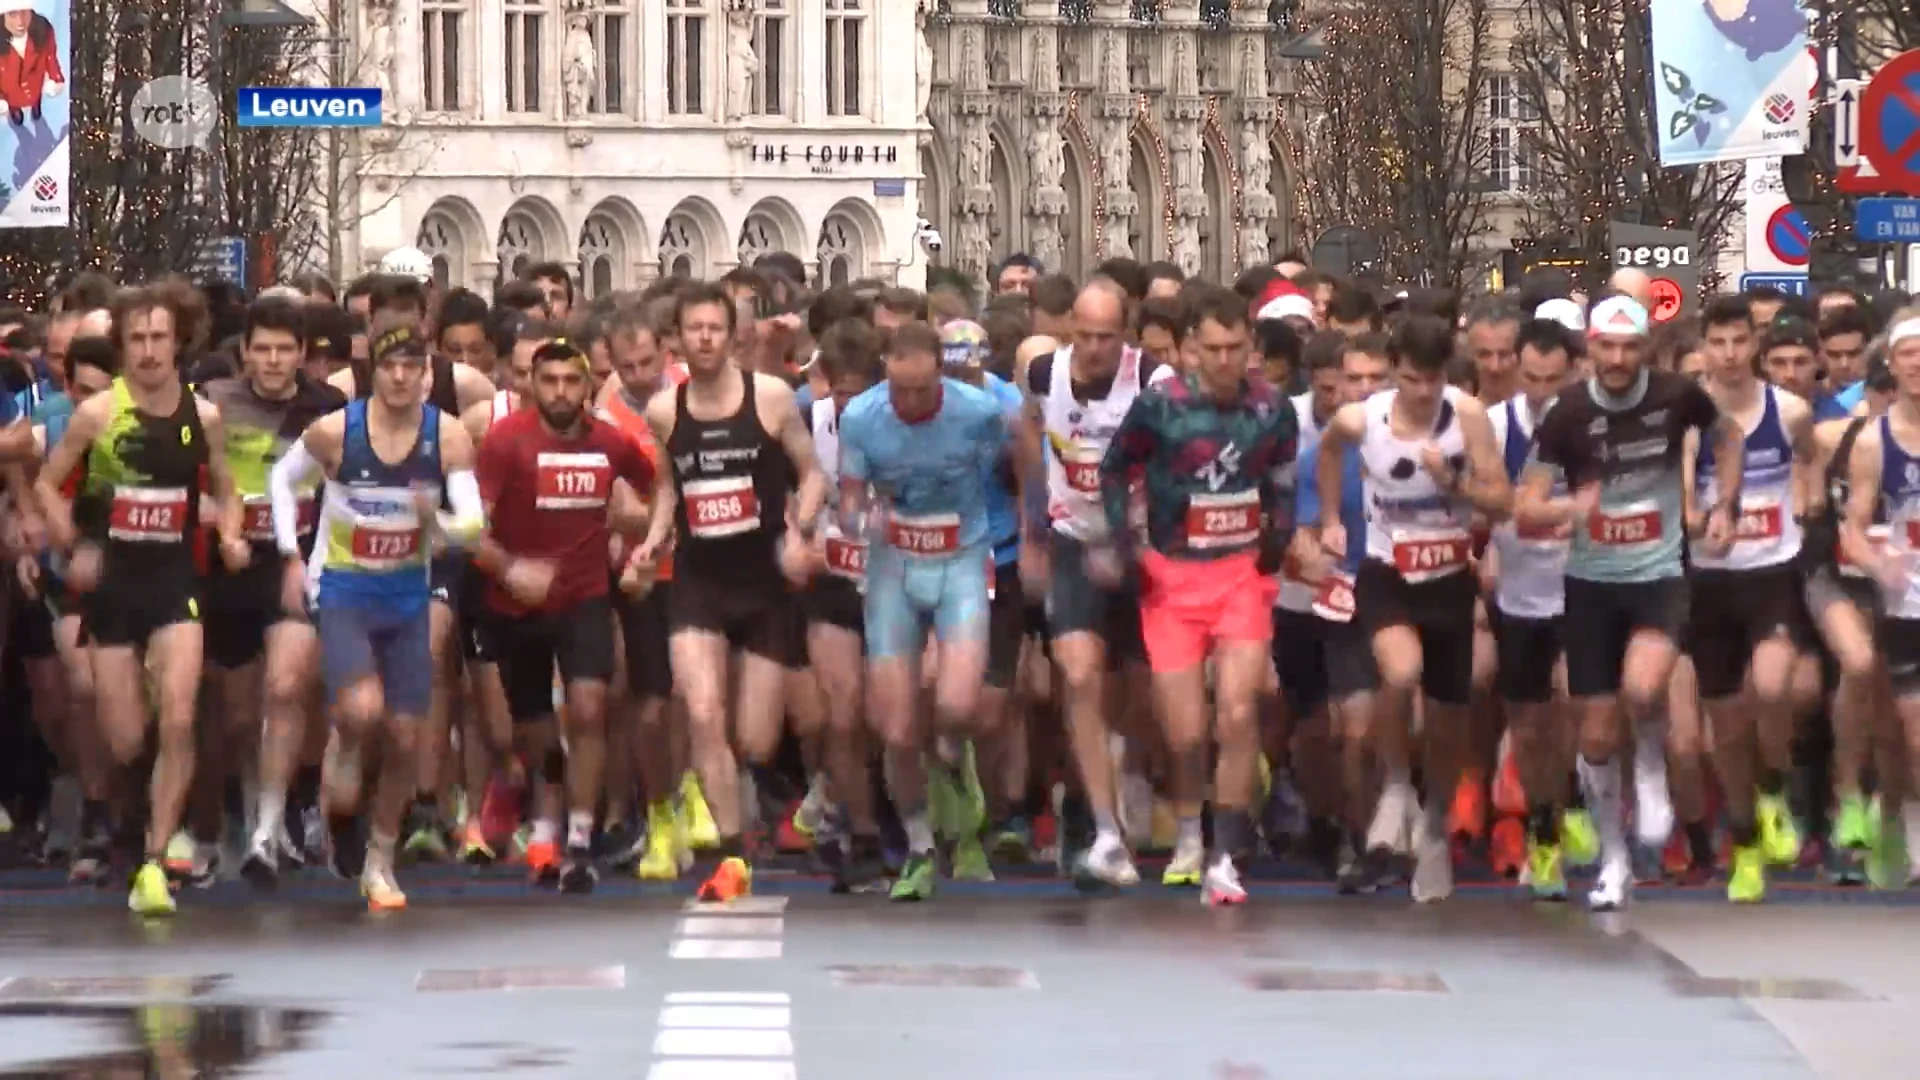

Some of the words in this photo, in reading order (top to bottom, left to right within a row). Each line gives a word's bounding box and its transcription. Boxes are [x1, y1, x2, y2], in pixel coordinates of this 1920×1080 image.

[1762, 129, 1799, 141] leuven
[752, 144, 789, 163] THE
[805, 145, 897, 163] FOURTH
[30, 203, 61, 213] leuven
[1892, 204, 1917, 219] VAN
[1877, 221, 1893, 236] EN
[556, 471, 596, 494] 1170
[126, 505, 172, 530] 4142
[695, 497, 743, 523] 2856
